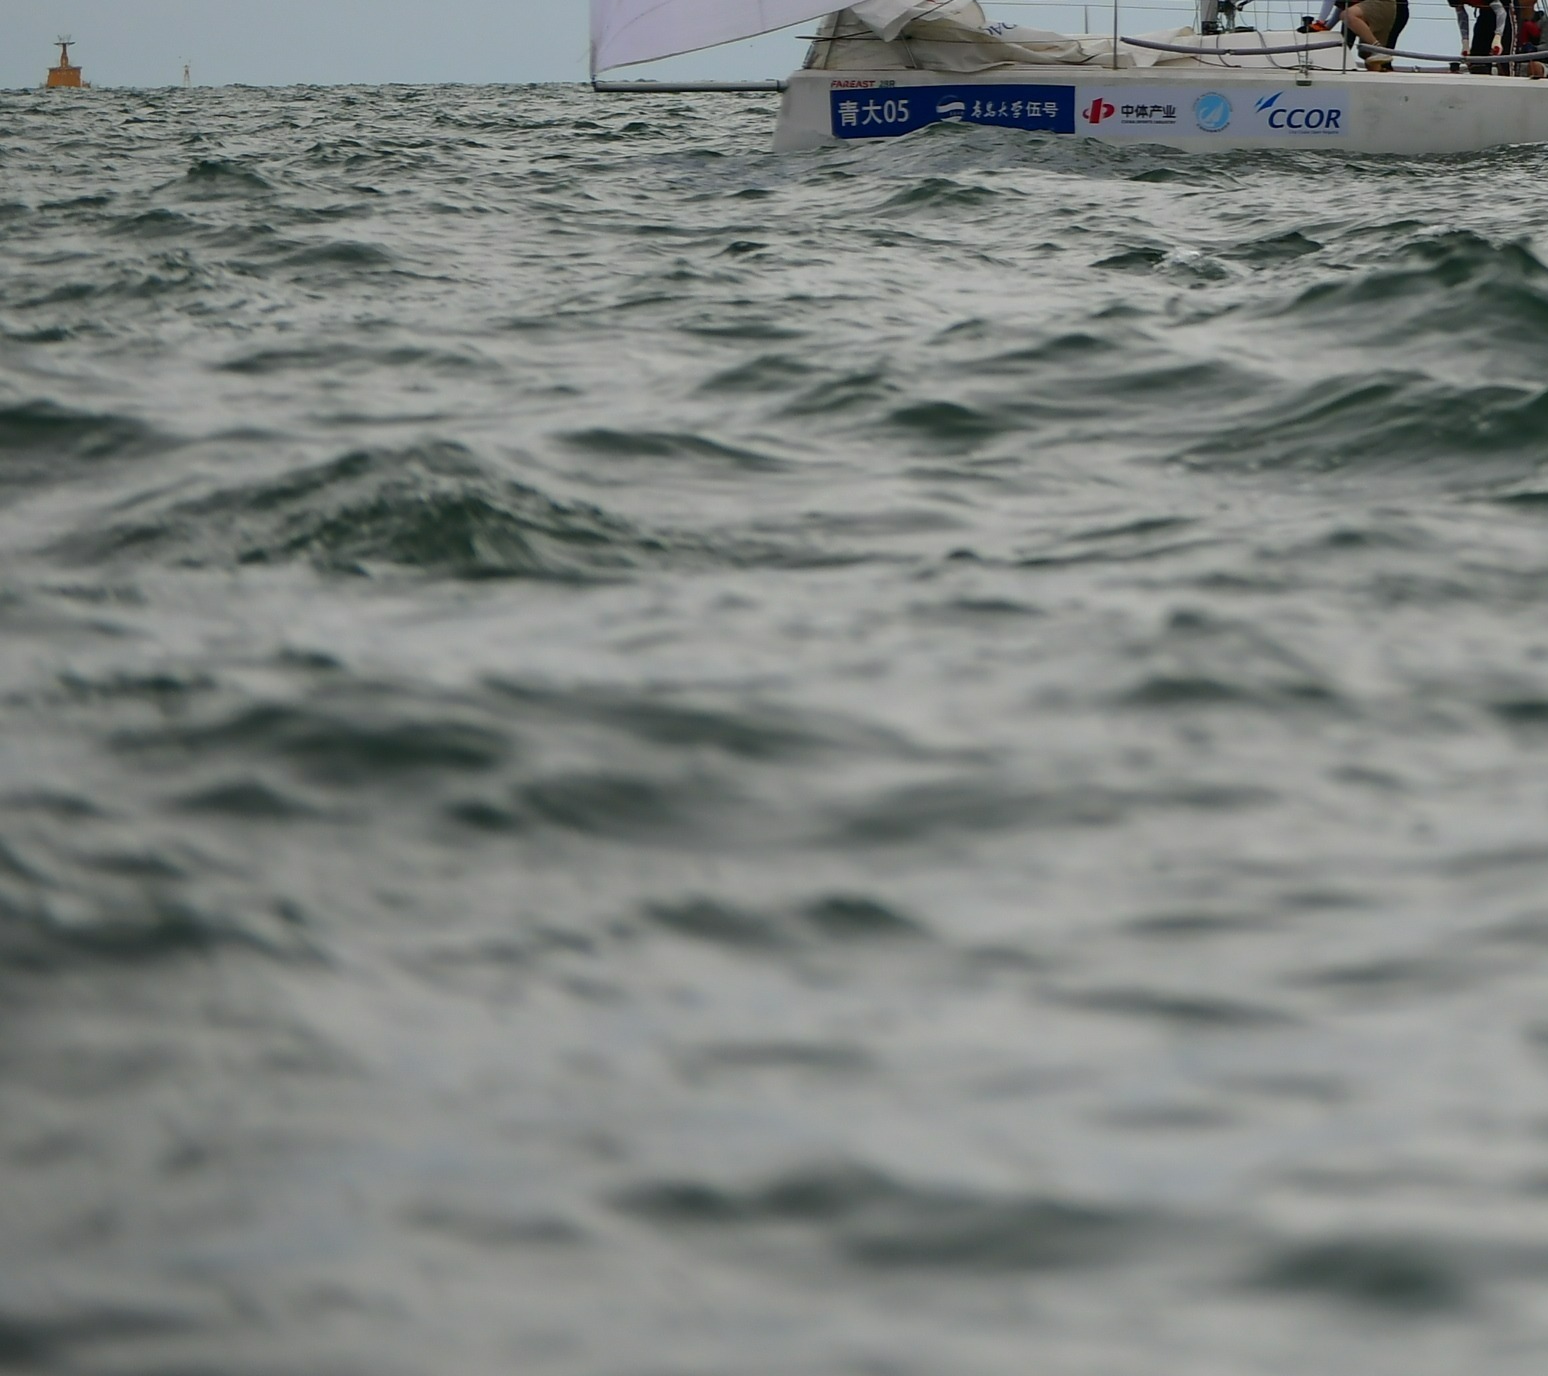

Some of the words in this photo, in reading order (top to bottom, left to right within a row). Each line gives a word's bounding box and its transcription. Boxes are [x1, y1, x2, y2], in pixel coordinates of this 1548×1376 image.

[831, 80, 876, 88] FAREAST
[838, 99, 910, 127] 青大05
[1121, 104, 1177, 119] 中体产业
[1267, 108, 1341, 129] CCOR
